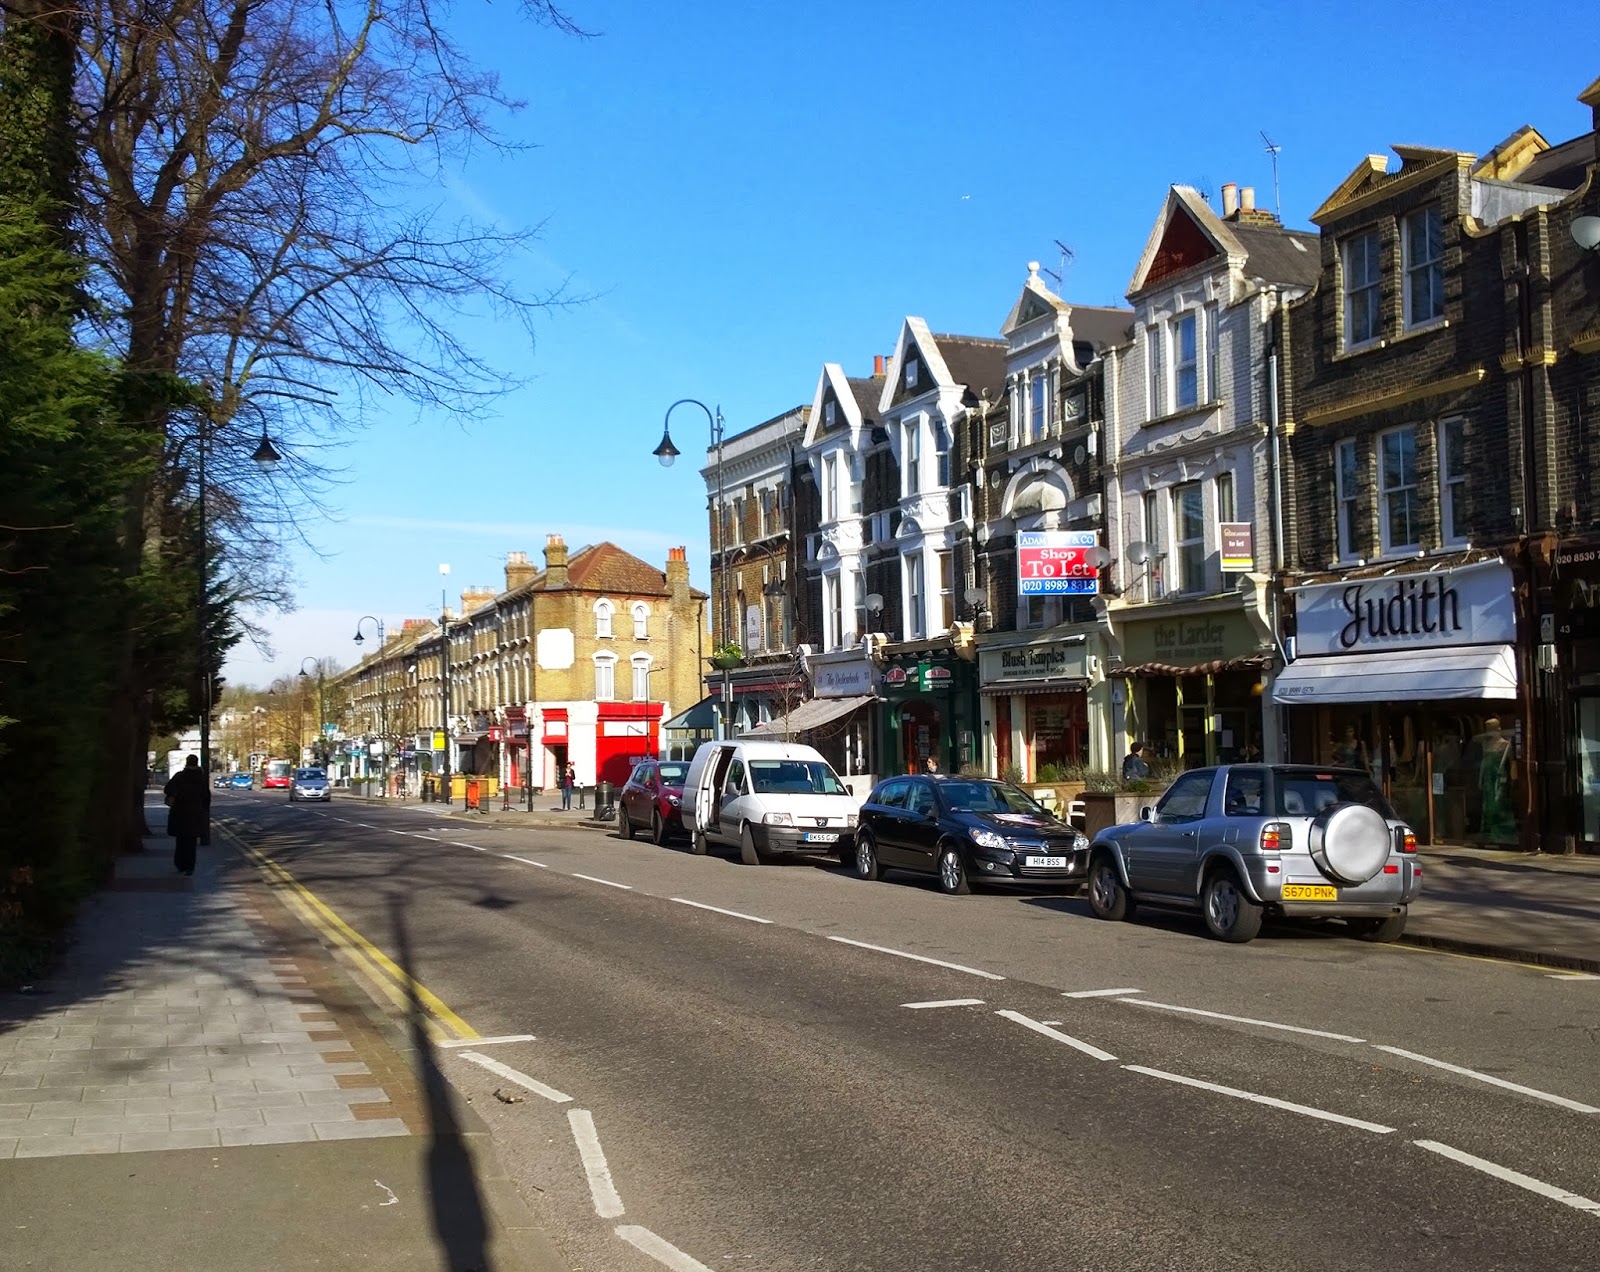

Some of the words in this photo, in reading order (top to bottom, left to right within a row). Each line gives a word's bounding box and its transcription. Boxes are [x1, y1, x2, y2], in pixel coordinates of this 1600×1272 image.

[1040, 549, 1076, 560] Shop
[1574, 552, 1595, 562] 8530
[1027, 561, 1054, 576] To
[1060, 560, 1090, 576] Let
[1024, 581, 1042, 591] 020
[1044, 580, 1068, 590] 8989
[1071, 581, 1094, 590] 8313
[1340, 576, 1462, 648] Judith
[1560, 625, 1570, 633] 43
[1002, 650, 1026, 668] Blush
[1028, 647, 1066, 671] Temples
[1284, 887, 1311, 897] S670
[1314, 888, 1334, 898] PNK
